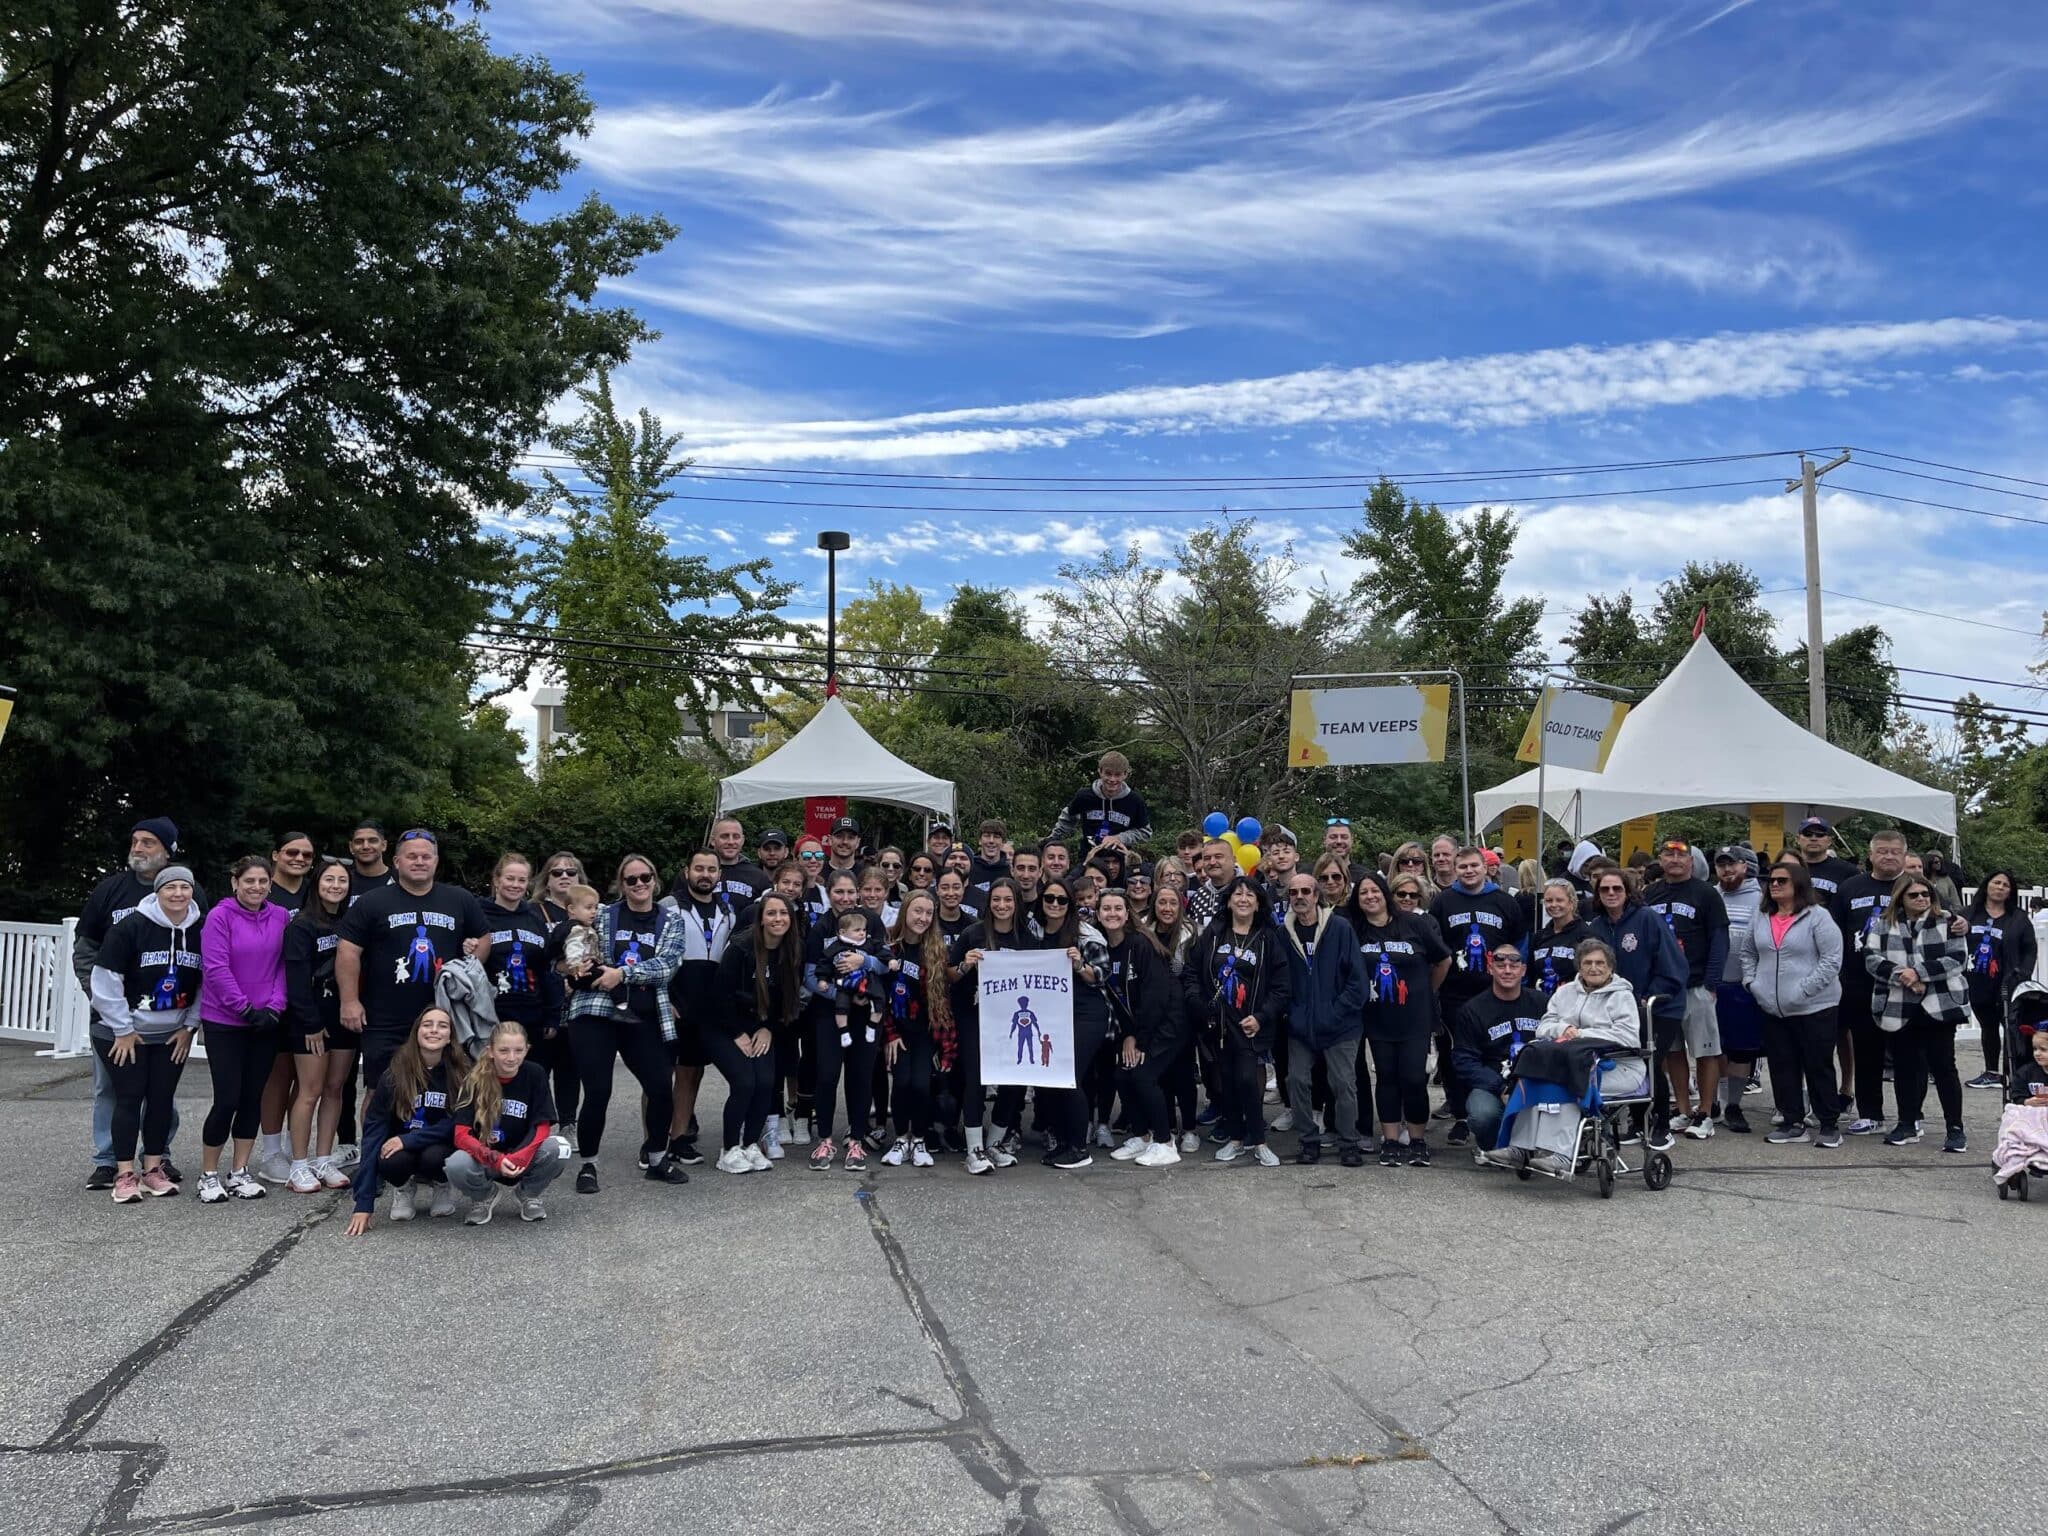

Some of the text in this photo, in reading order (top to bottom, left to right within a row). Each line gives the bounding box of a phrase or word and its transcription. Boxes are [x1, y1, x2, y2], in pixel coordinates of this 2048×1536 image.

[1320, 719, 1418, 736] TEAM VEEPS
[1545, 721, 1603, 742] GOLD TEAMS
[814, 812, 837, 820] VEEPS
[388, 911, 455, 931] TEAM VEEPS
[1475, 911, 1502, 930] VEEPS
[140, 950, 202, 969] TEAM VEEP
[983, 974, 1069, 995] TEAM VEEPS
[1488, 1021, 1512, 1041] TEAM
